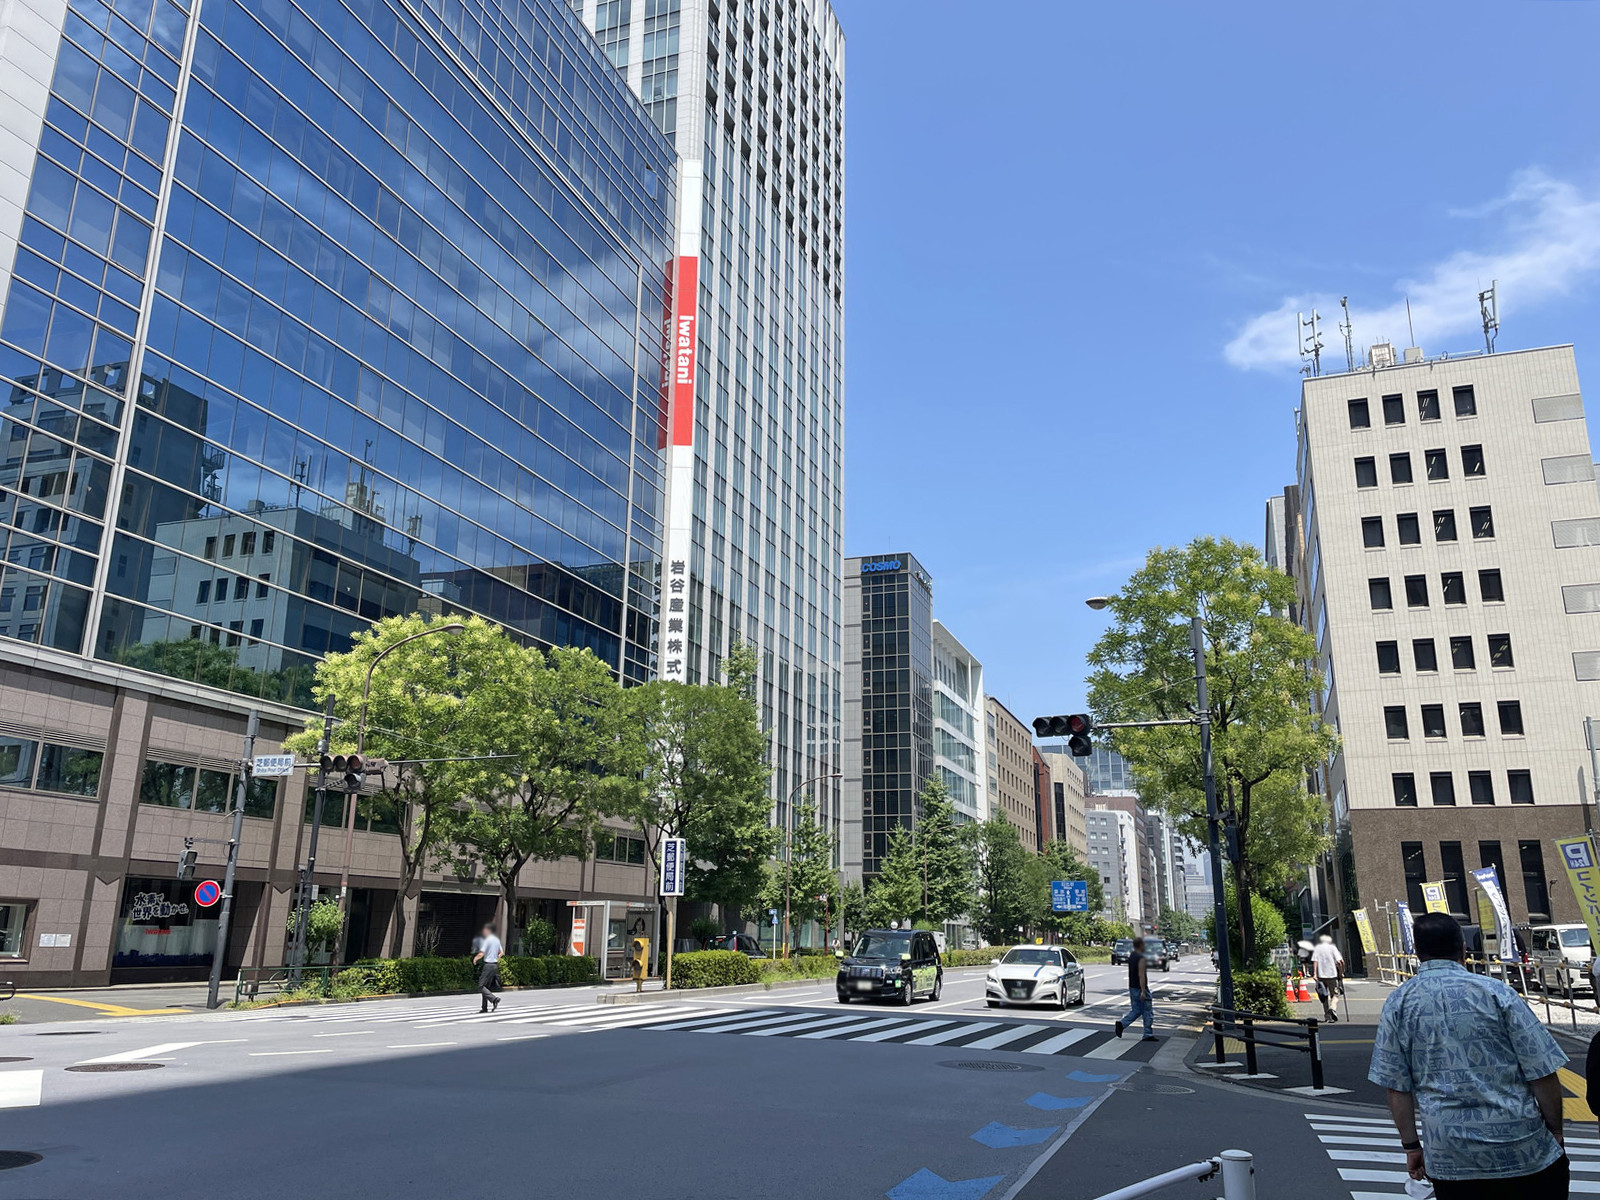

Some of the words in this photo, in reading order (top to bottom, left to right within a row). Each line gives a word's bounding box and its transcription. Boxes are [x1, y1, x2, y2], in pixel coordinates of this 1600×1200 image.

[677, 315, 694, 384] Iwatani
[862, 560, 901, 573] COSMO
[256, 757, 291, 767] 芝郵便局前
[666, 843, 675, 891] 芝郵便局前
